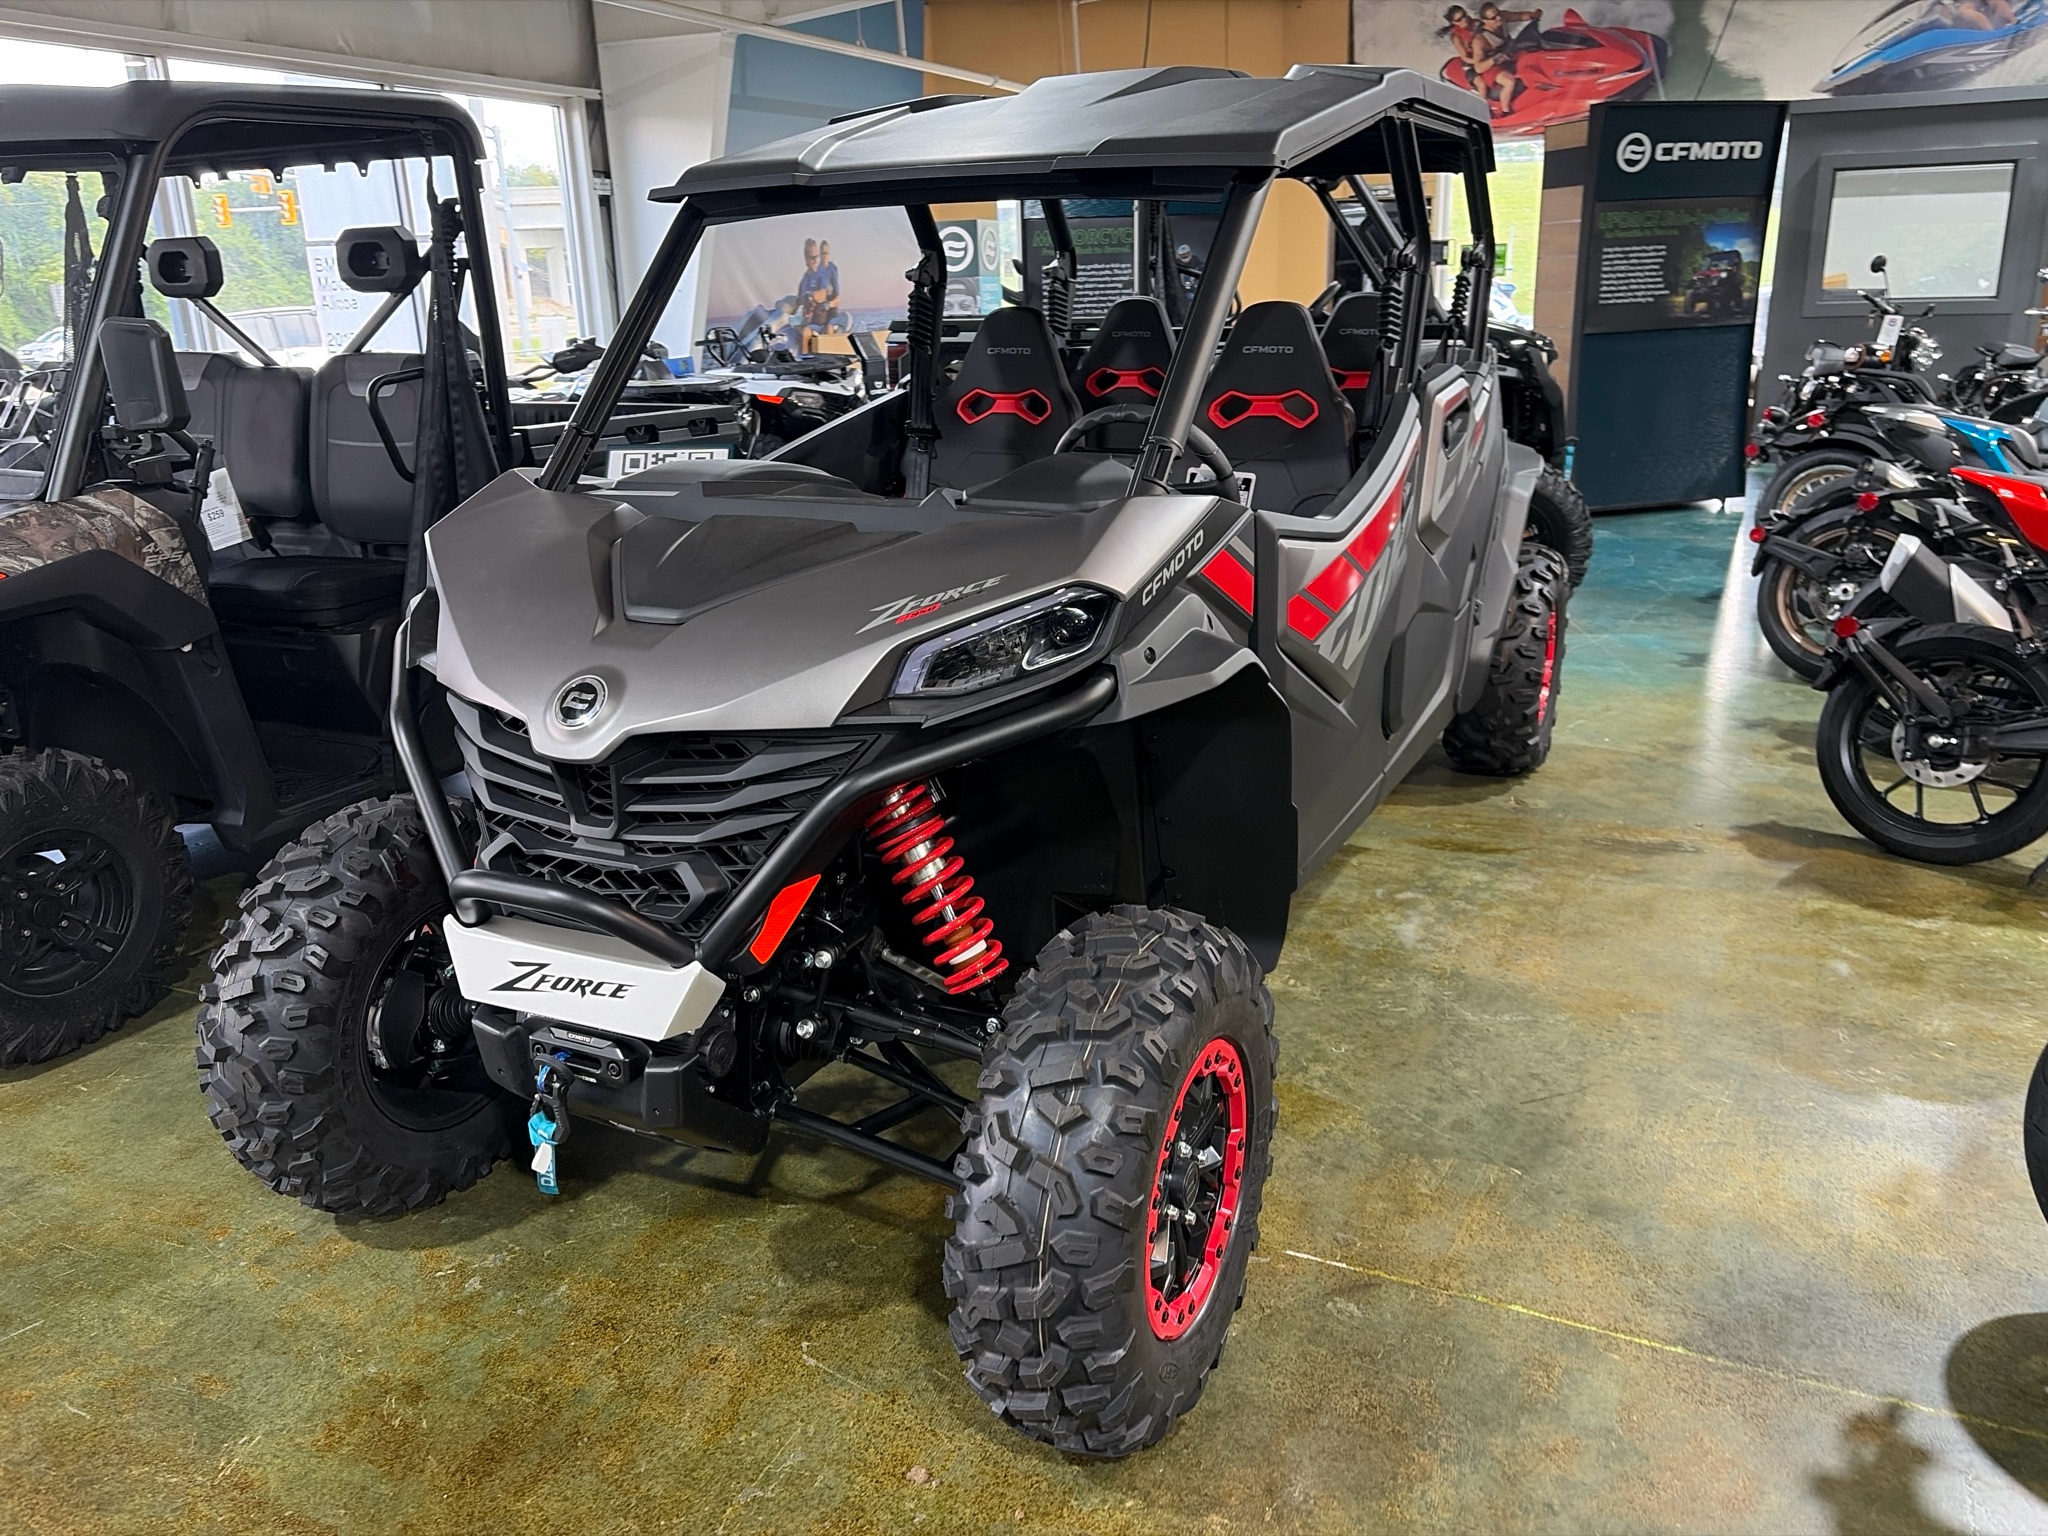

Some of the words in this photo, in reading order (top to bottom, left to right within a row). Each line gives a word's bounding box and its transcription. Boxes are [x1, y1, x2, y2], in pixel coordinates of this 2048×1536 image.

[1655, 141, 1763, 161] CFMOTO
[987, 347, 1031, 355] CFMOTO
[1242, 345, 1294, 354] CFMOTO
[1142, 529, 1204, 606] CFMOTO
[855, 573, 1011, 635] ZFORCE
[488, 960, 638, 999] ZFORCE
[567, 1032, 591, 1043] CFMOTO
